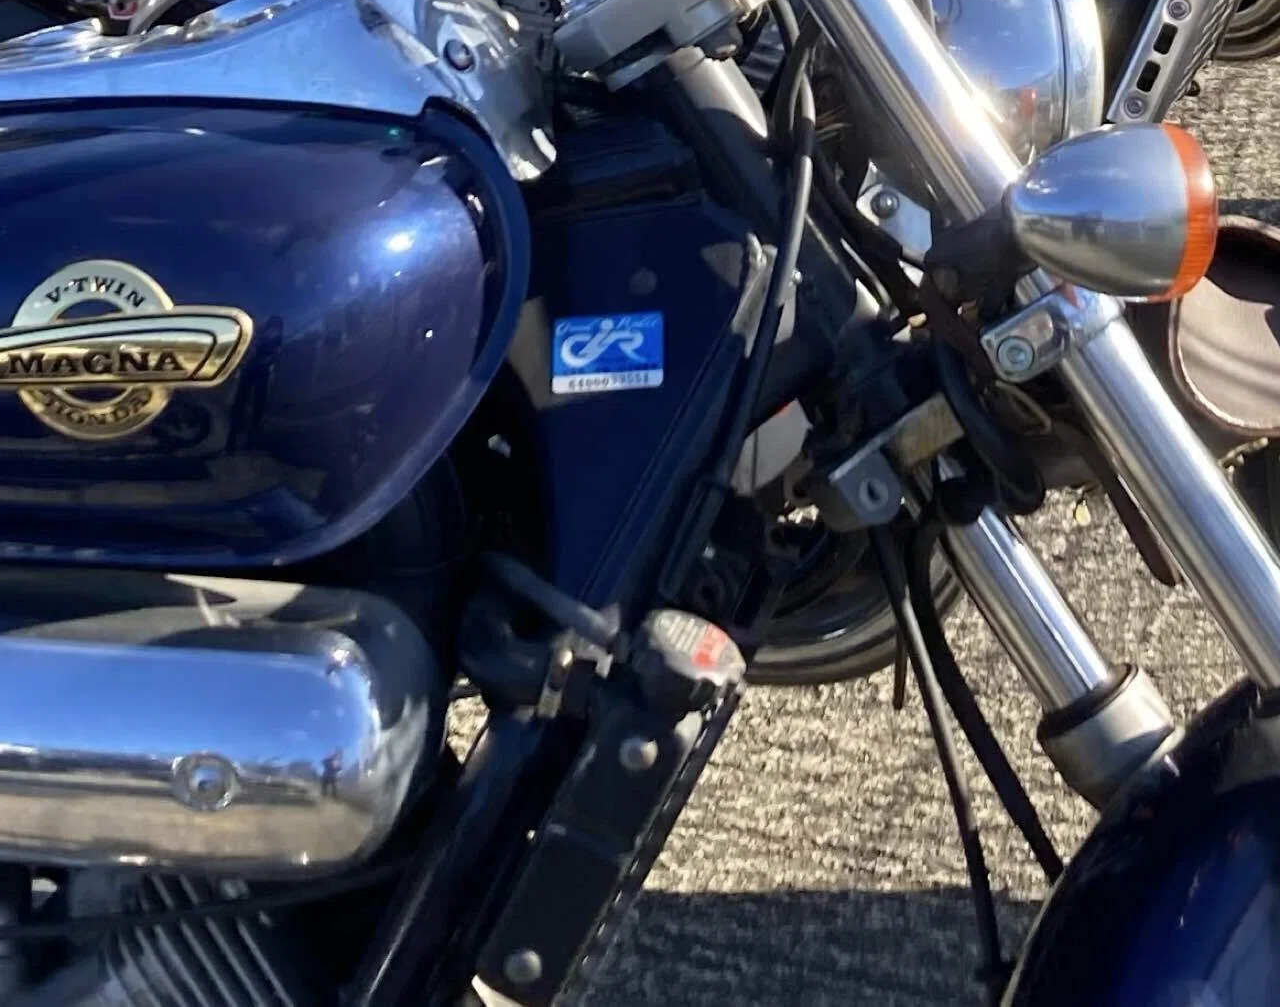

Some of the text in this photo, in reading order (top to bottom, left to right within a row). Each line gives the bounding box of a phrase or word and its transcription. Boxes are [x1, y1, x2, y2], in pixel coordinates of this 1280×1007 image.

[45, 275, 147, 309] V-TWIN
[8, 349, 187, 376] MAGNA
[42, 387, 151, 426] HONDA
